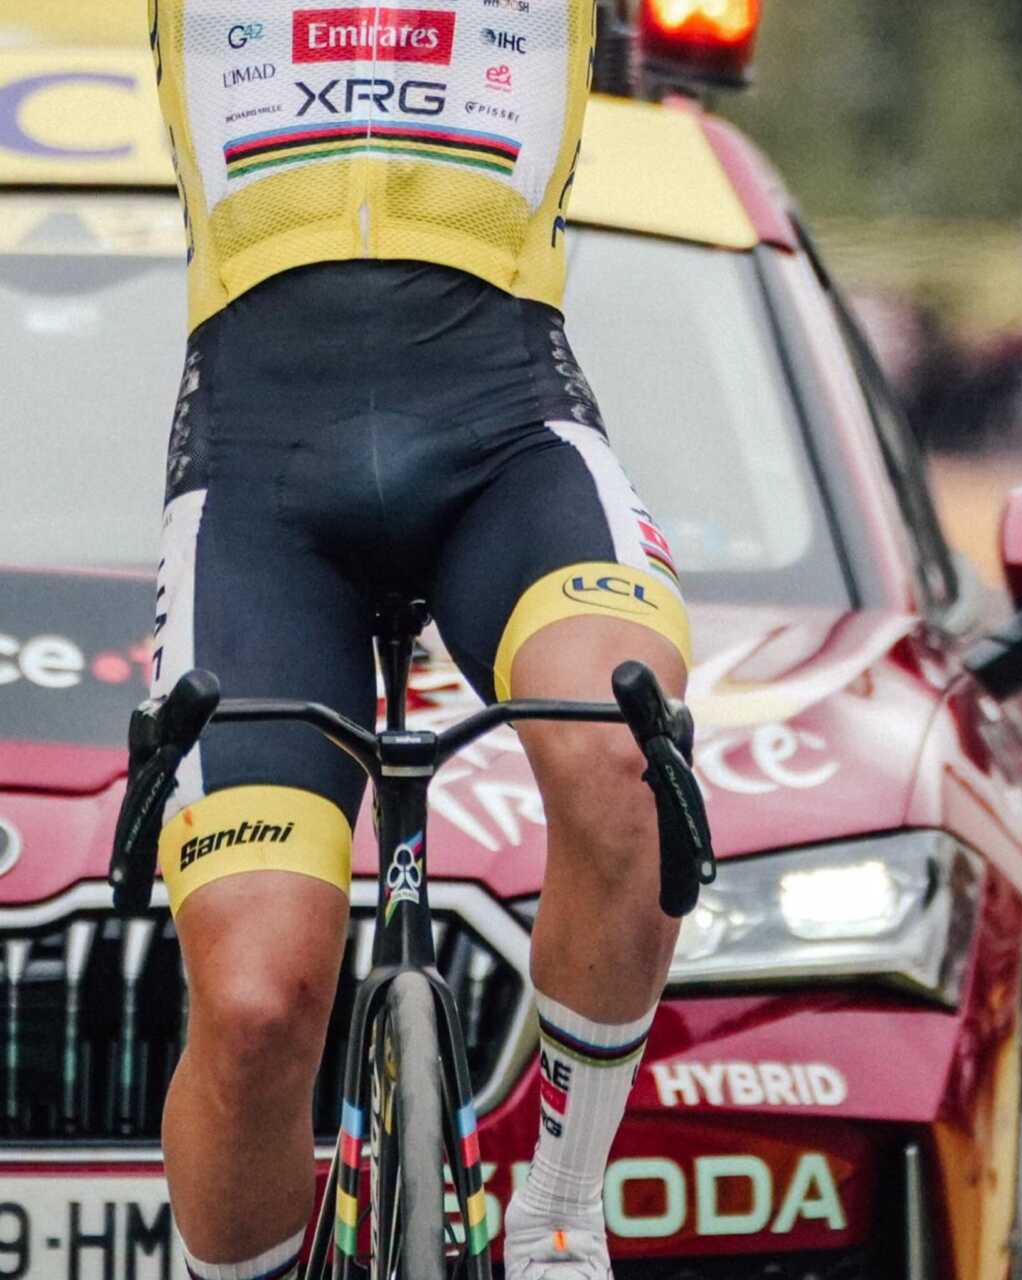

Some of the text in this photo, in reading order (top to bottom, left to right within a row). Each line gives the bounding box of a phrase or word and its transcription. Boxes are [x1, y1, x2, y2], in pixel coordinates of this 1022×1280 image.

[307, 21, 440, 50] Emirates
[498, 31, 527, 55] IHC
[294, 78, 447, 116] XRG
[572, 575, 659, 610] LCL
[180, 820, 296, 872] Santini
[650, 1061, 849, 1108] HYBRID
